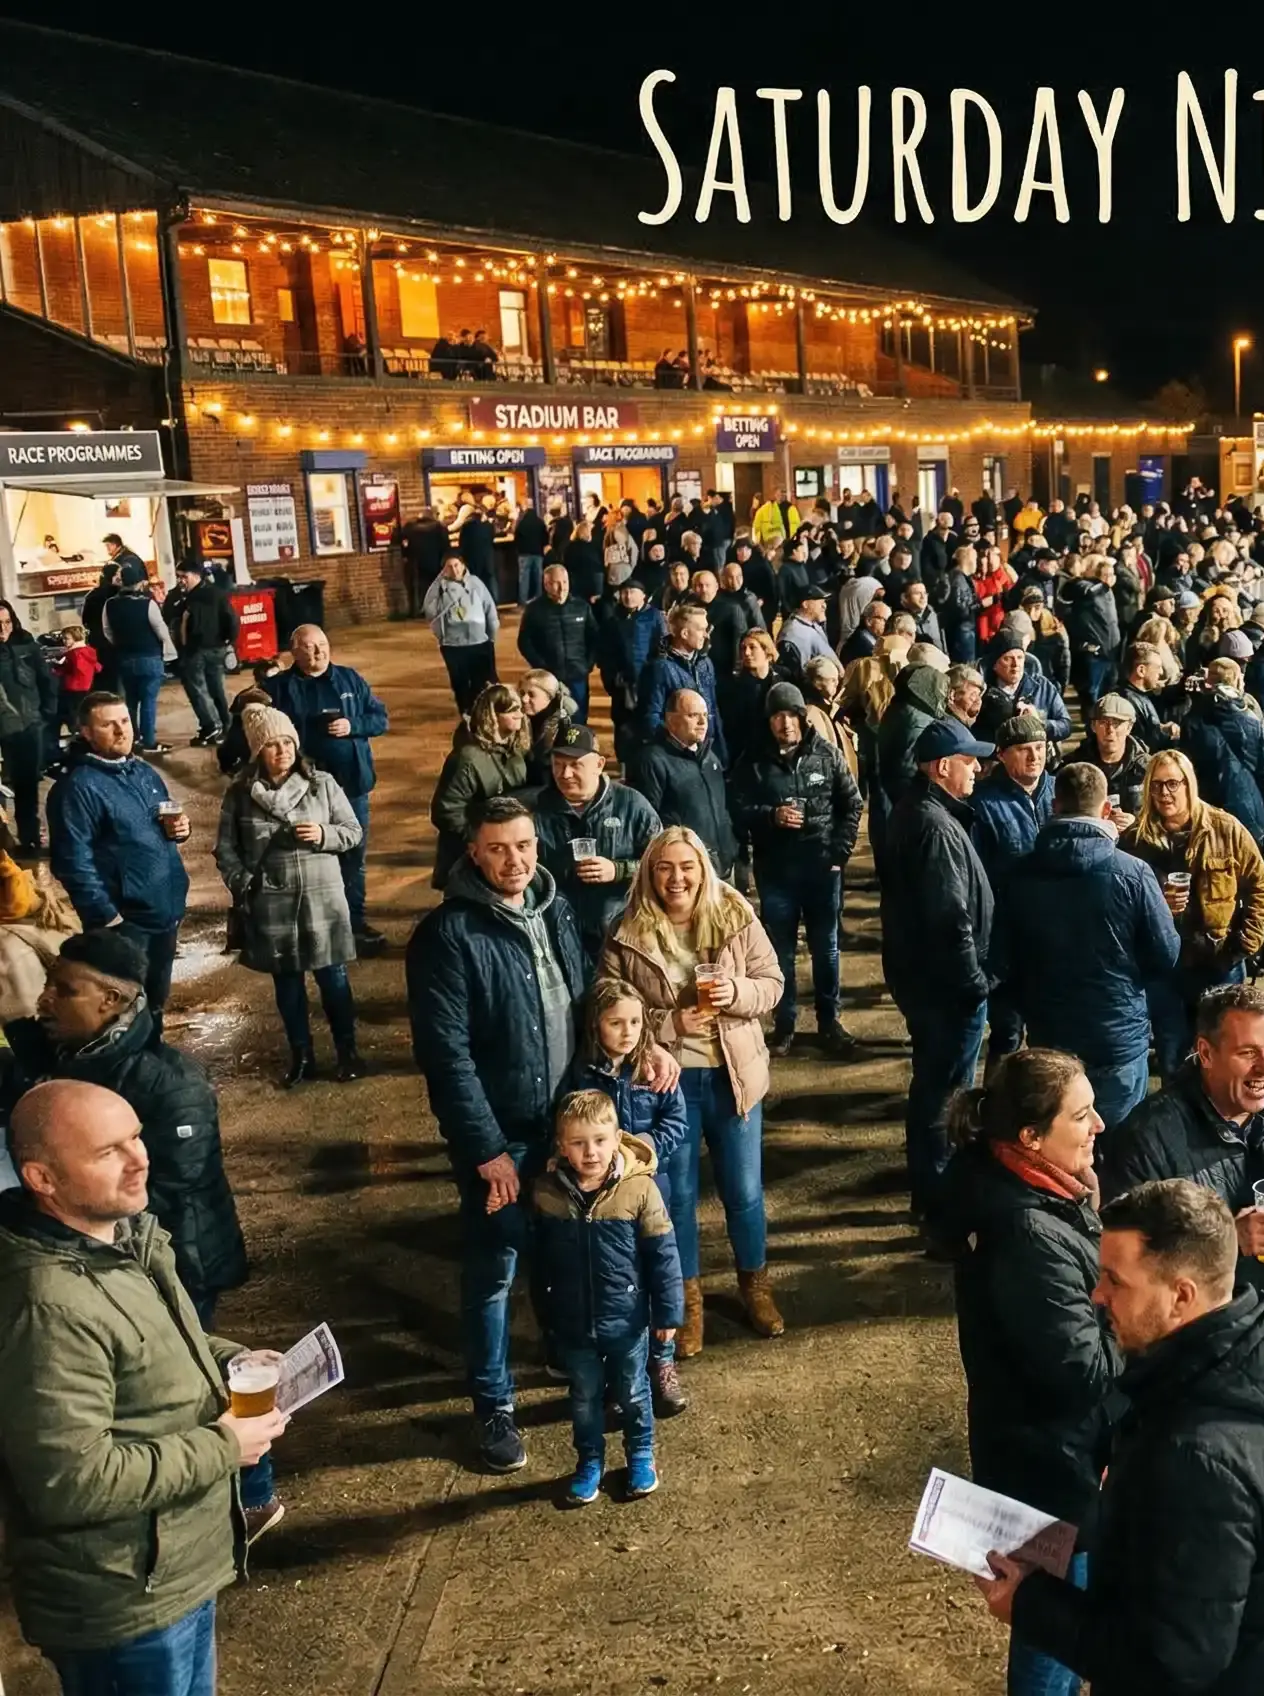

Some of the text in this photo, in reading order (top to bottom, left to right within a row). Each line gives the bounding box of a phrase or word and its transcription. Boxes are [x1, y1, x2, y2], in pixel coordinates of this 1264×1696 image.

[495, 404, 619, 429] STADIUM BAR
[723, 416, 769, 432] BETTING
[735, 434, 760, 448] OPEN
[7, 444, 142, 464] RACE PROGRAMMES
[450, 449, 525, 465] BETTING OPEN
